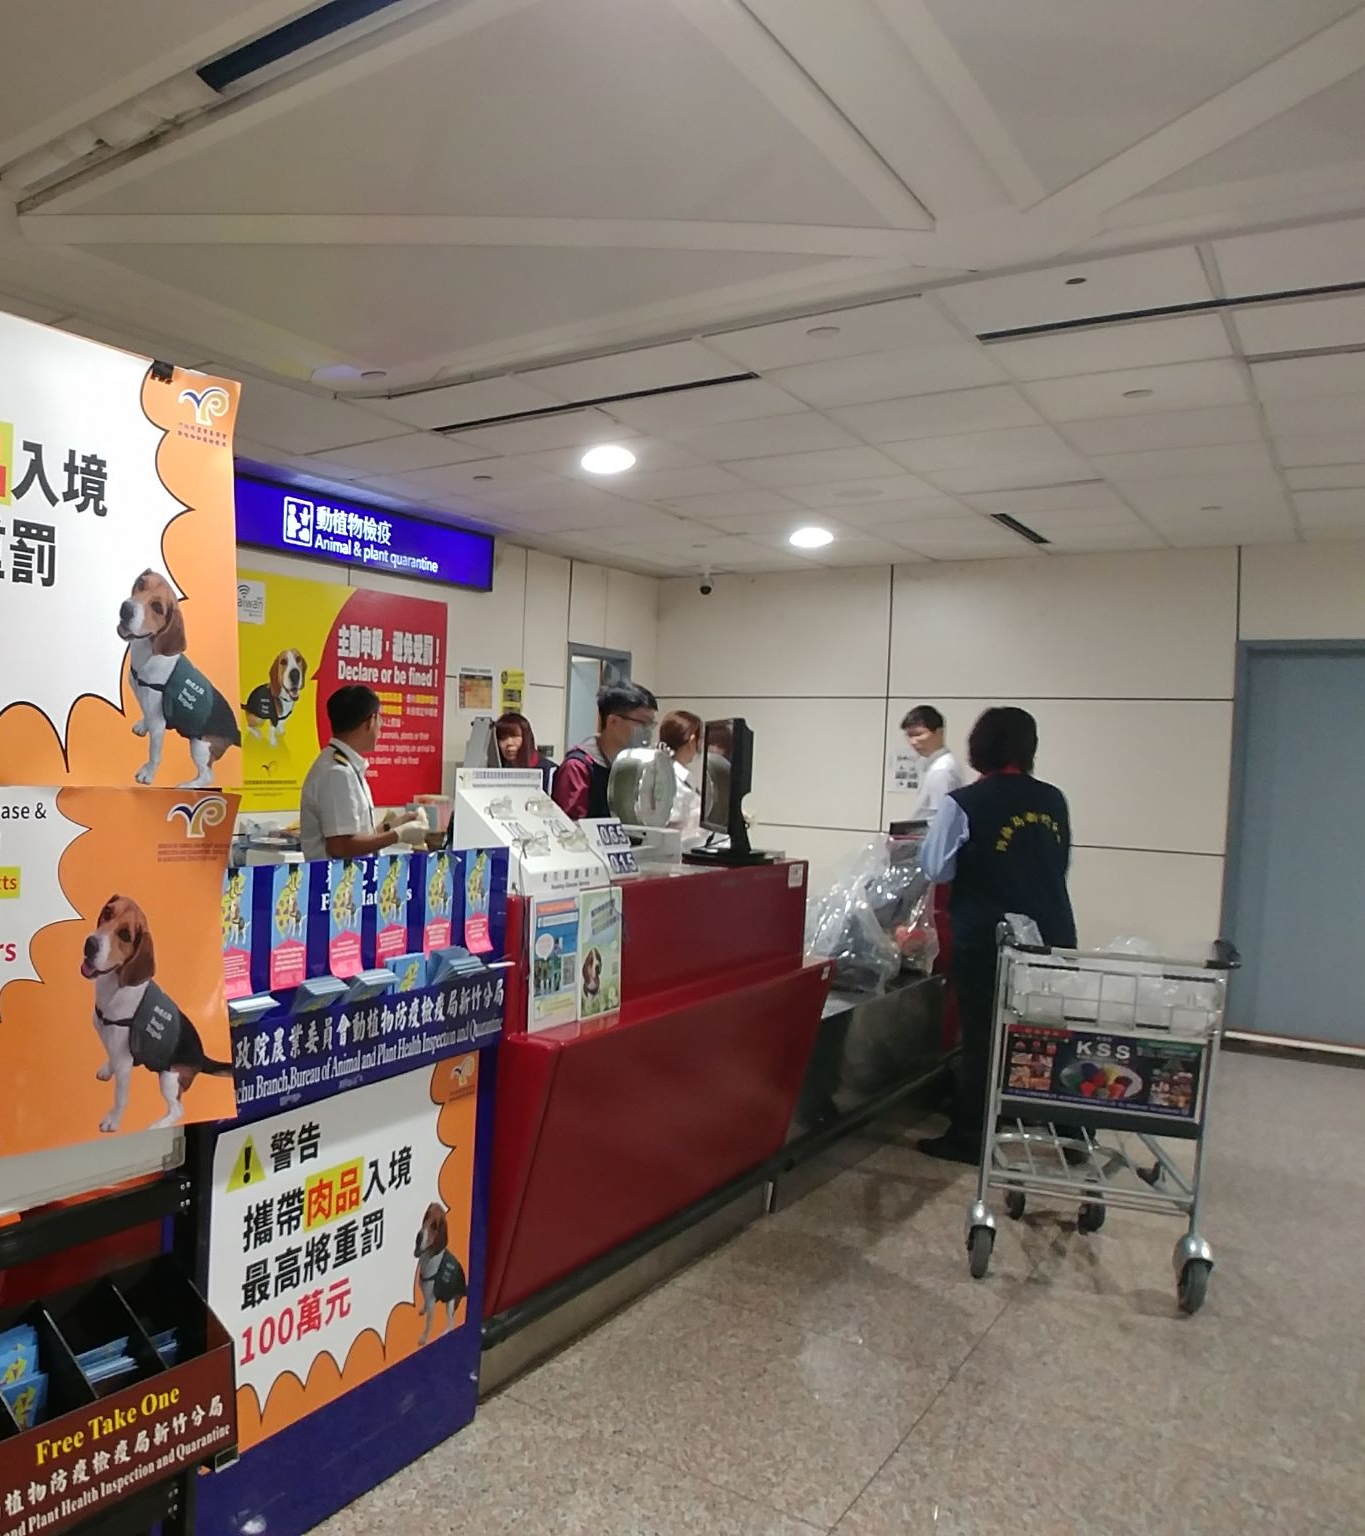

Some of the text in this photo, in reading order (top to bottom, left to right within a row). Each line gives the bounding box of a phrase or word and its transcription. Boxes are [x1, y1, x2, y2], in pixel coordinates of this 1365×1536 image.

[315, 505, 393, 546] 動植物檢疫
[315, 534, 438, 573] Animal & plant quarantine
[338, 660, 378, 682] Declare
[380, 668, 392, 683] or
[394, 666, 407, 684] be
[408, 667, 432, 687] fined
[34, 801, 47, 820] &
[235, 978, 504, 1070] 政院農業委員會動植物防疫檢疫局新竹分局
[321, 1056, 332, 1080] of
[331, 1049, 361, 1079] Animal
[362, 1046, 376, 1070] and
[377, 1043, 397, 1065] Plant
[398, 1033, 421, 1060] Health
[270, 1122, 321, 1173] 警告
[242, 1146, 412, 1252] 攜帶肉品入境
[241, 1208, 385, 1311] 最高將重罰
[240, 1277, 351, 1366] 100萬元
[35, 1387, 180, 1466] Free Take One
[27, 1505, 60, 1534] Plant
[61, 1486, 99, 1516] Health
[100, 1462, 155, 1497] Inspection
[156, 1449, 175, 1470] and
[176, 1424, 231, 1461] Quarantine
